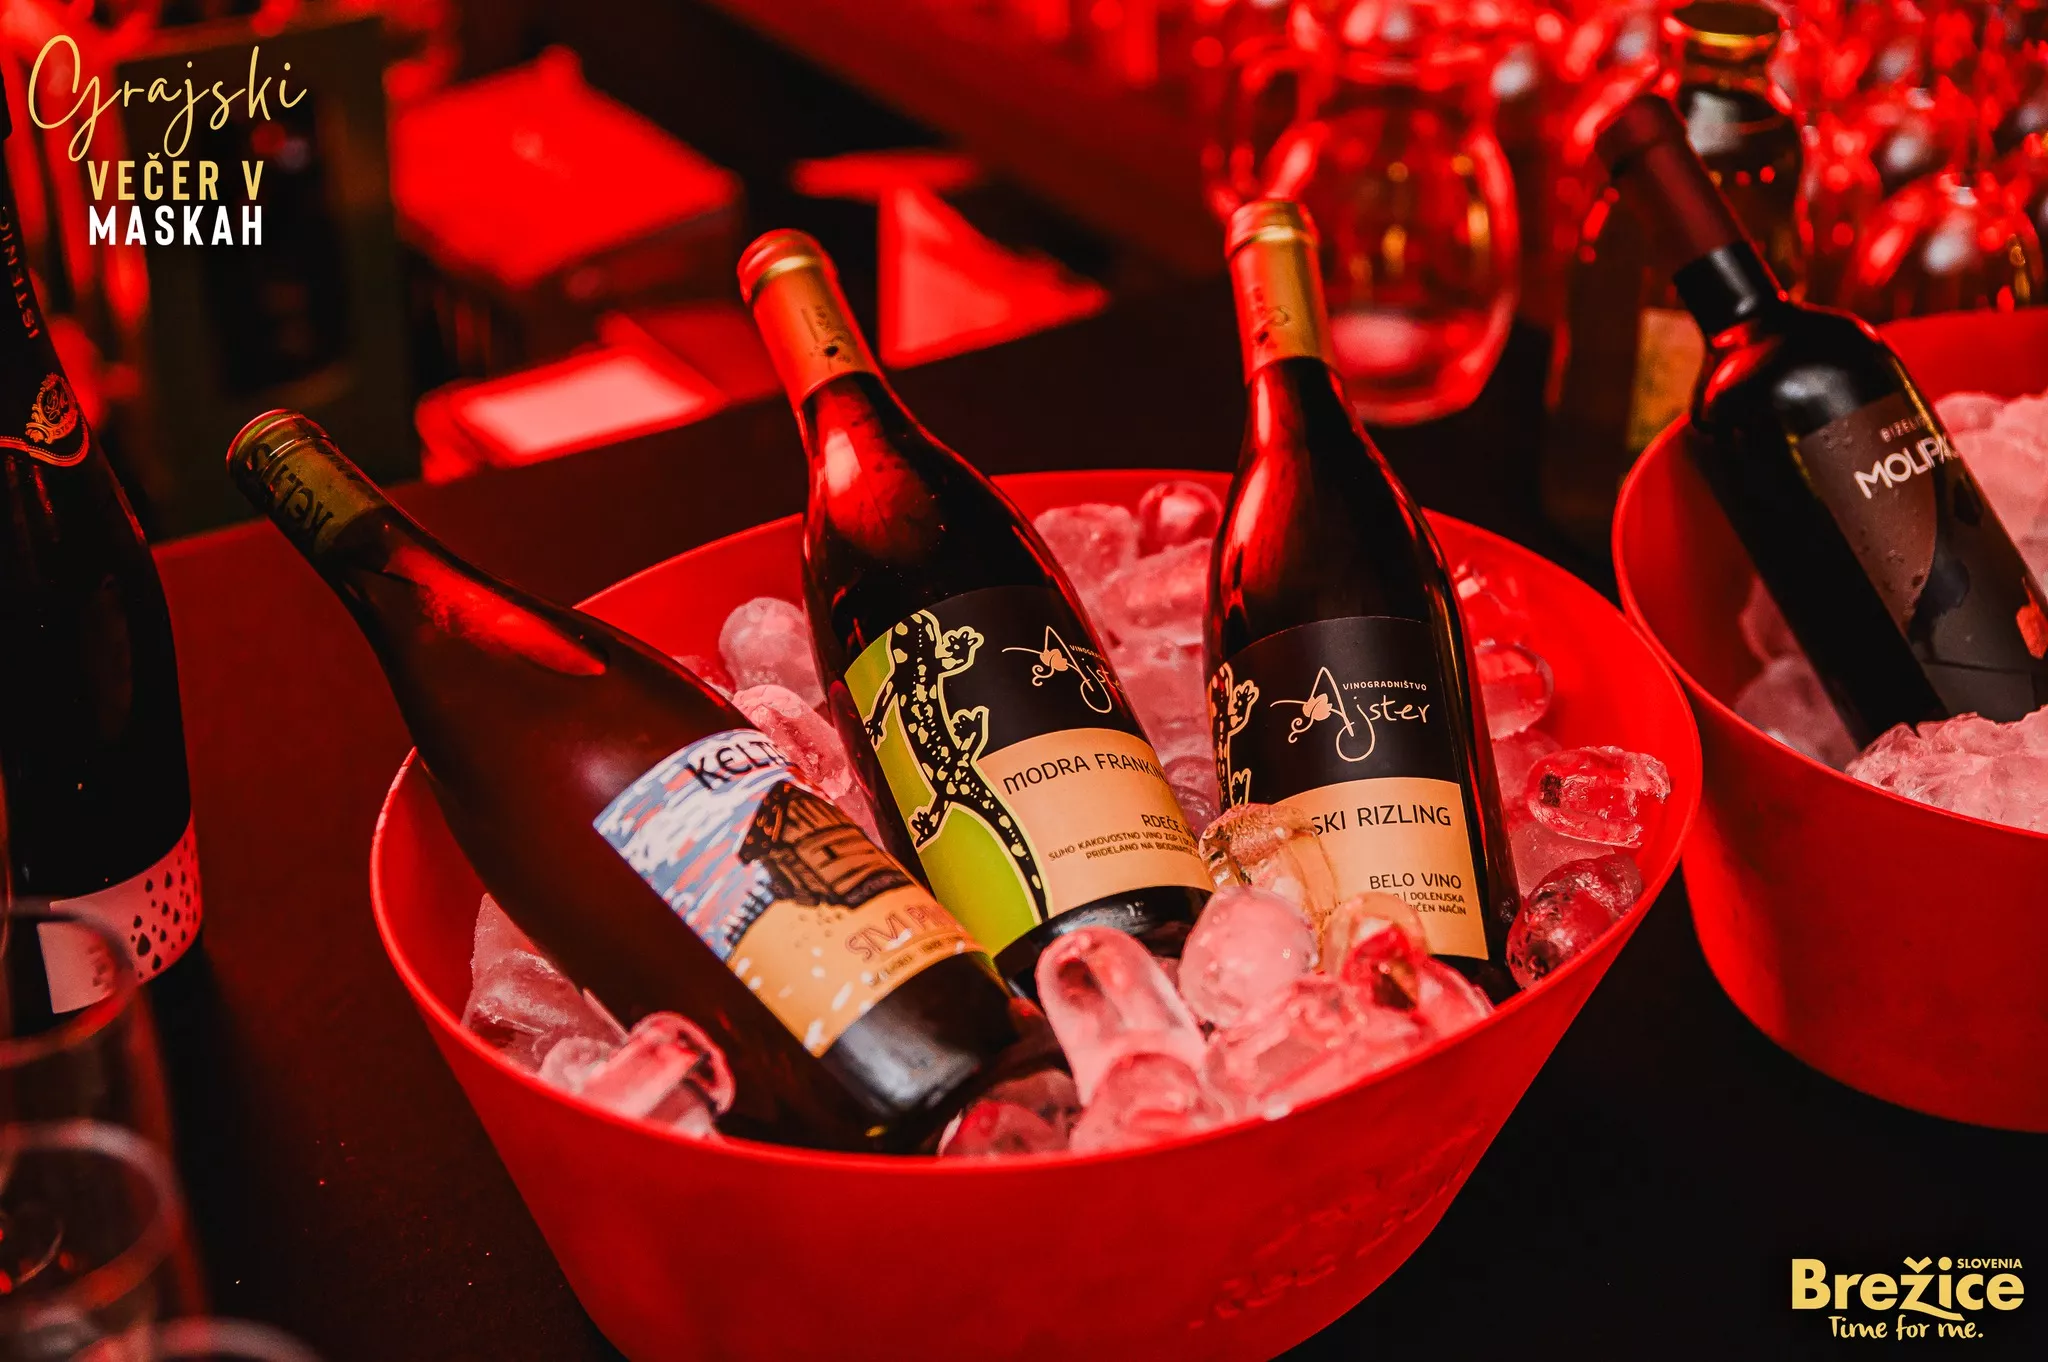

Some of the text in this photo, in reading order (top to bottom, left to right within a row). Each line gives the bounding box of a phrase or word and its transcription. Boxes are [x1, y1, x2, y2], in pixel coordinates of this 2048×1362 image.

[1342, 680, 1427, 691] VINOGRADNIŠTVO
[1278, 667, 1430, 762] Ajster
[1003, 755, 1091, 795] MODRA
[1141, 814, 1183, 834] RDEČE
[1311, 804, 1451, 836] SKI RIZLING
[1048, 845, 1075, 861] SUHO
[1077, 831, 1141, 850] KAKOVOSTNO
[1086, 843, 1139, 860] PRIDELANO
[1369, 872, 1462, 889] BELO VINO
[1410, 891, 1465, 903] DOLENJSKA
